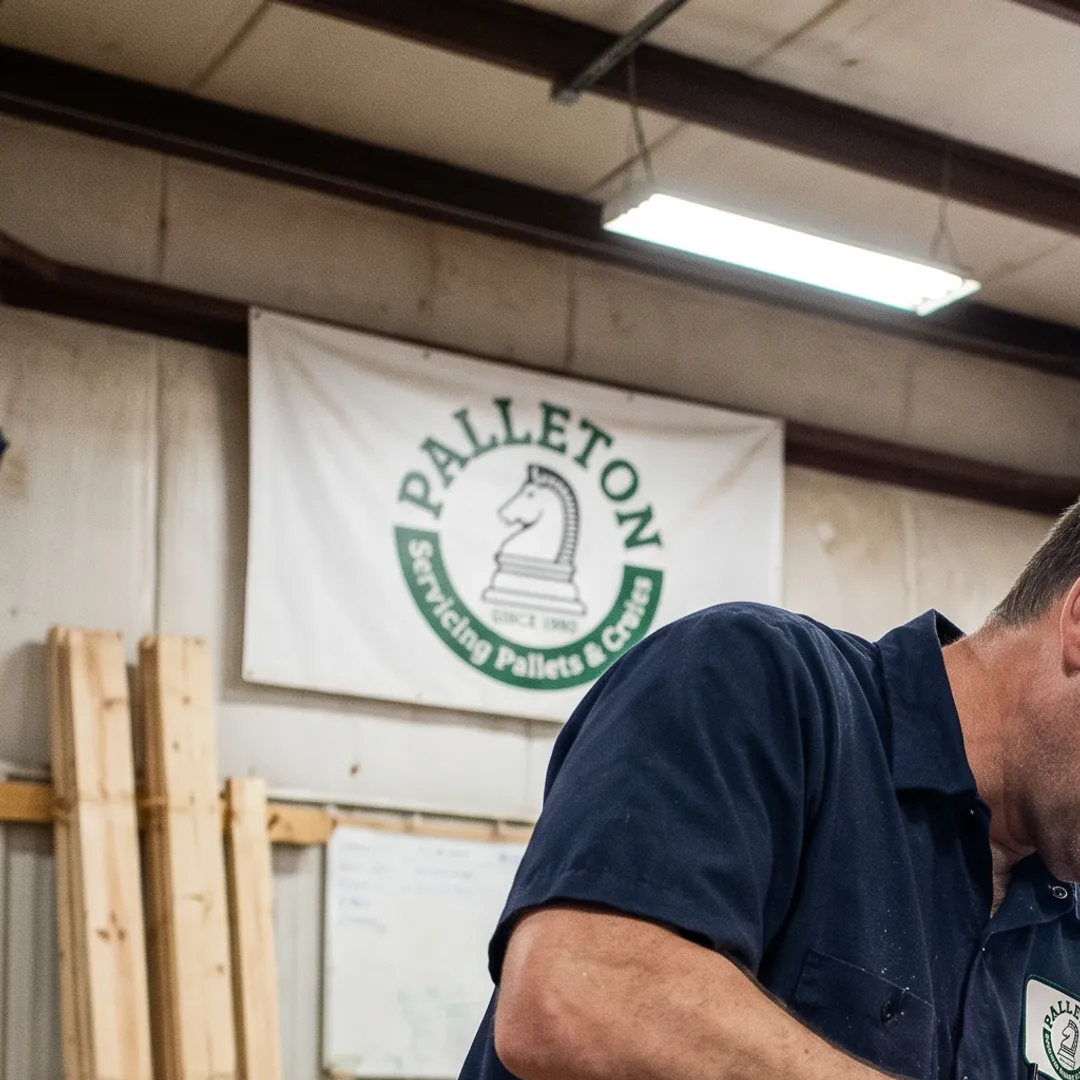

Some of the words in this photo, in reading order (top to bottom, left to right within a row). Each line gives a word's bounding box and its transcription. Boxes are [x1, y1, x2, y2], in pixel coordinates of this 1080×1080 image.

[397, 397, 663, 551] PALLETON
[408, 538, 493, 665] Servicing
[494, 647, 584, 680] Pallets
[583, 642, 607, 669] &
[601, 575, 653, 653] Crates
